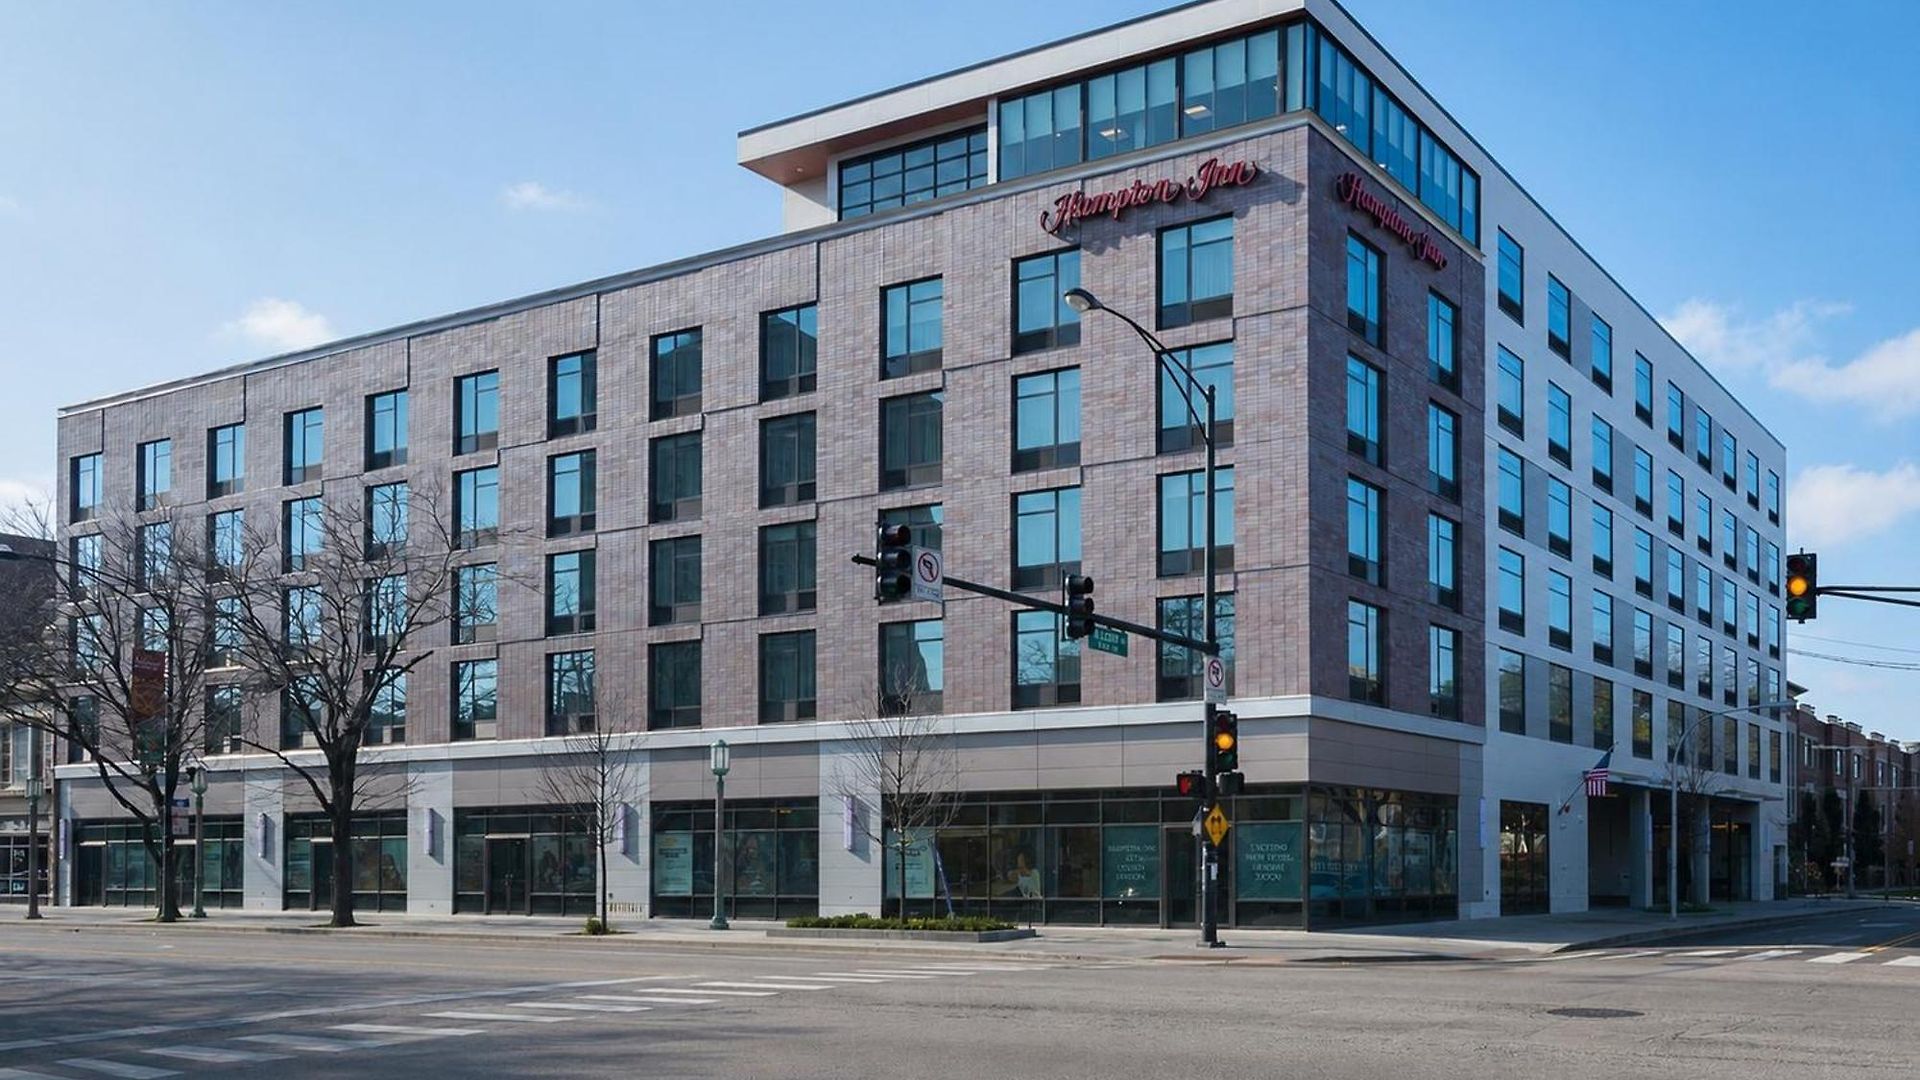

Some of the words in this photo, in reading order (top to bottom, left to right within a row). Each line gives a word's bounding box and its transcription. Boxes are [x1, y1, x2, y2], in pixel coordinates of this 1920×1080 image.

[1040, 177, 1182, 234] Hampton
[1186, 157, 1258, 201] Inn
[1337, 172, 1417, 245] Hampton
[1417, 233, 1447, 270] Inn
